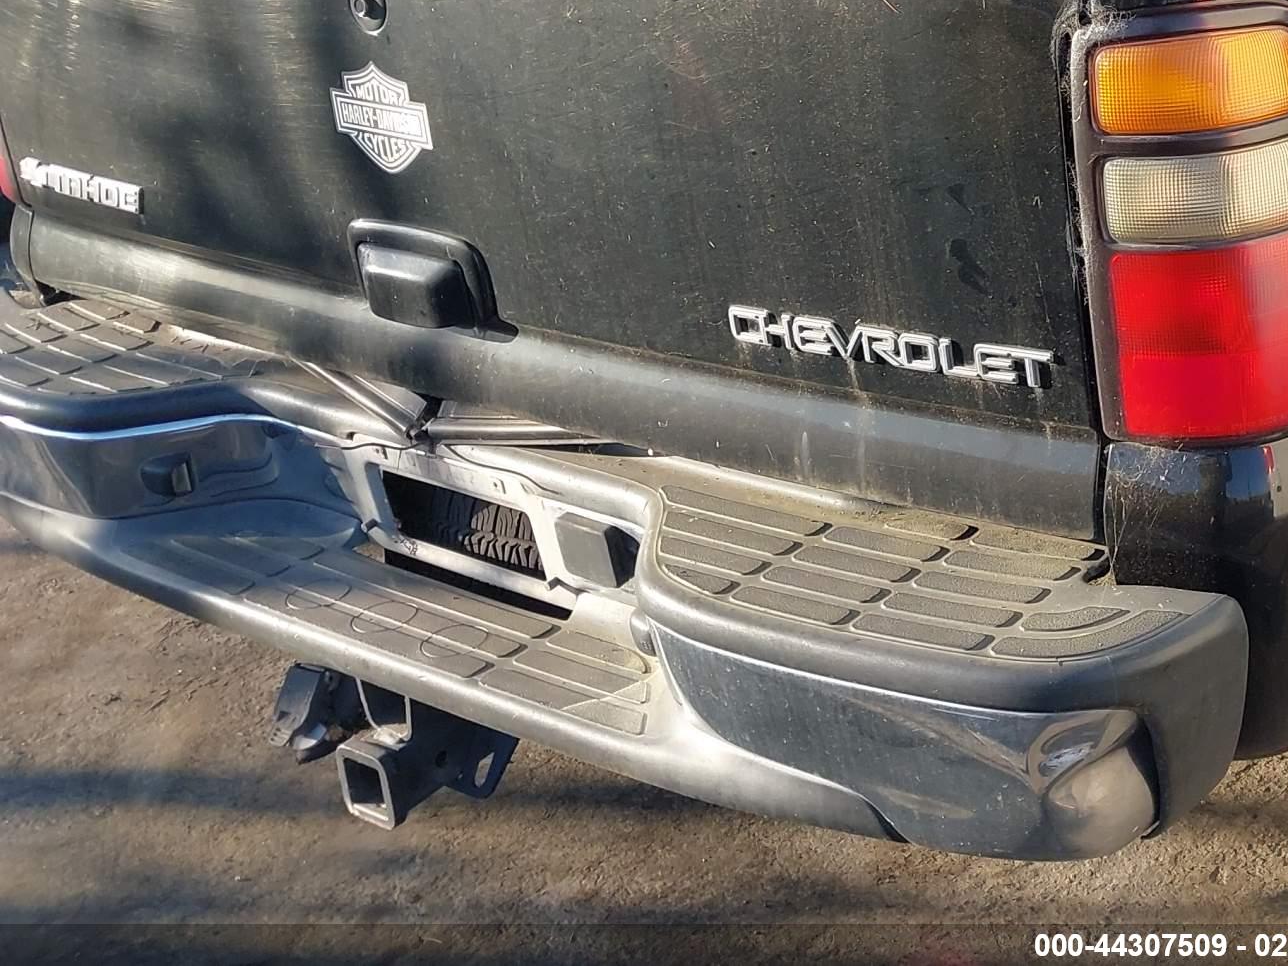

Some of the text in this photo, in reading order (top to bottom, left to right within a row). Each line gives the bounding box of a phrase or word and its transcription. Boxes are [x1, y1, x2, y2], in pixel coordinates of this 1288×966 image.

[355, 81, 402, 106] MOTOR
[363, 133, 407, 163] CYCLES
[728, 304, 1055, 388] CHEVROLET
